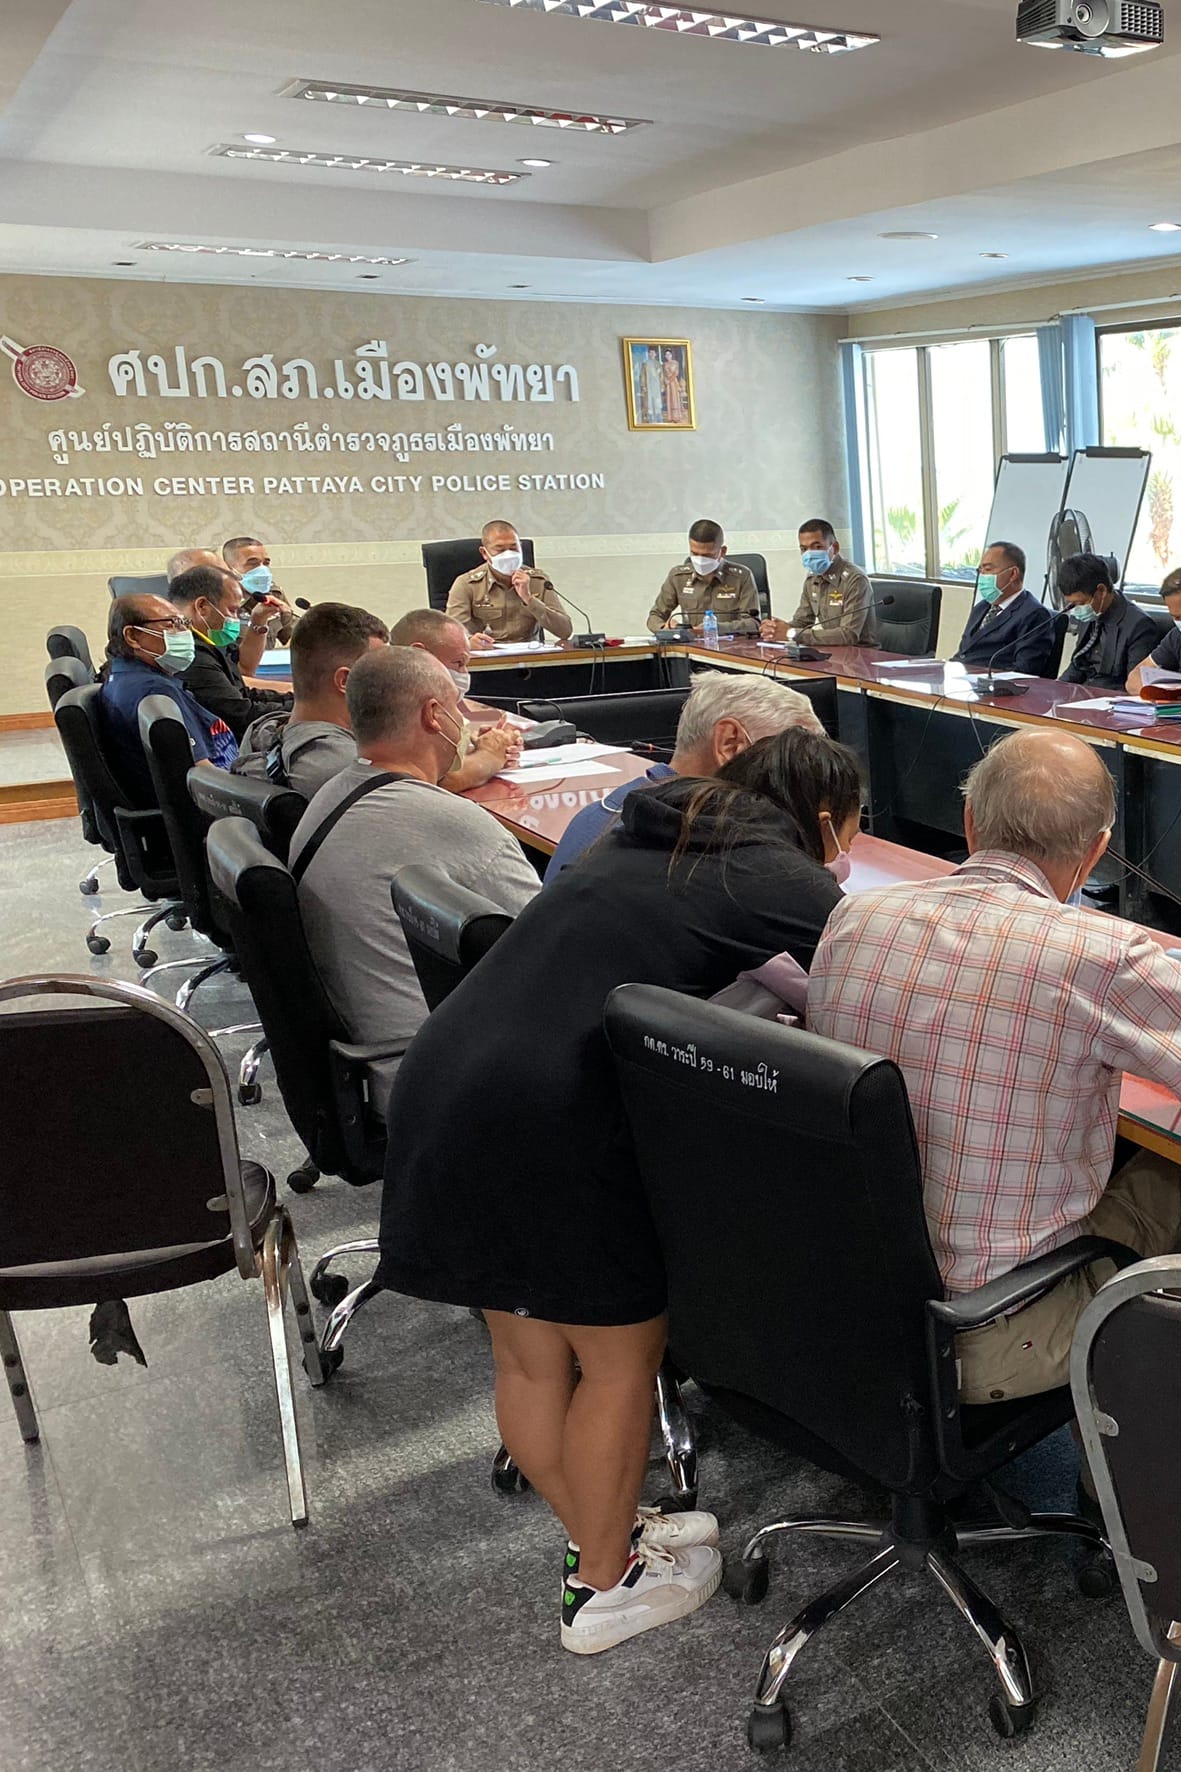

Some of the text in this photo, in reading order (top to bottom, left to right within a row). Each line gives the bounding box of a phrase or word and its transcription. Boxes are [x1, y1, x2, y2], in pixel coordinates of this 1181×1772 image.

[108, 340, 580, 401] ศปก.สภ.เมืองพัทยา
[48, 421, 554, 464] ศูนย์ปฏิบัติการสถานีตำรวจภูธรเมืองพัทยา
[154, 476, 255, 495] CENTER
[264, 475, 364, 494] PATTAYA
[371, 475, 423, 492] CITY
[432, 474, 511, 491] POLICE
[518, 473, 605, 490] STATION
[700, 1057, 713, 1072] 59
[740, 1062, 779, 1093] มอบให้
